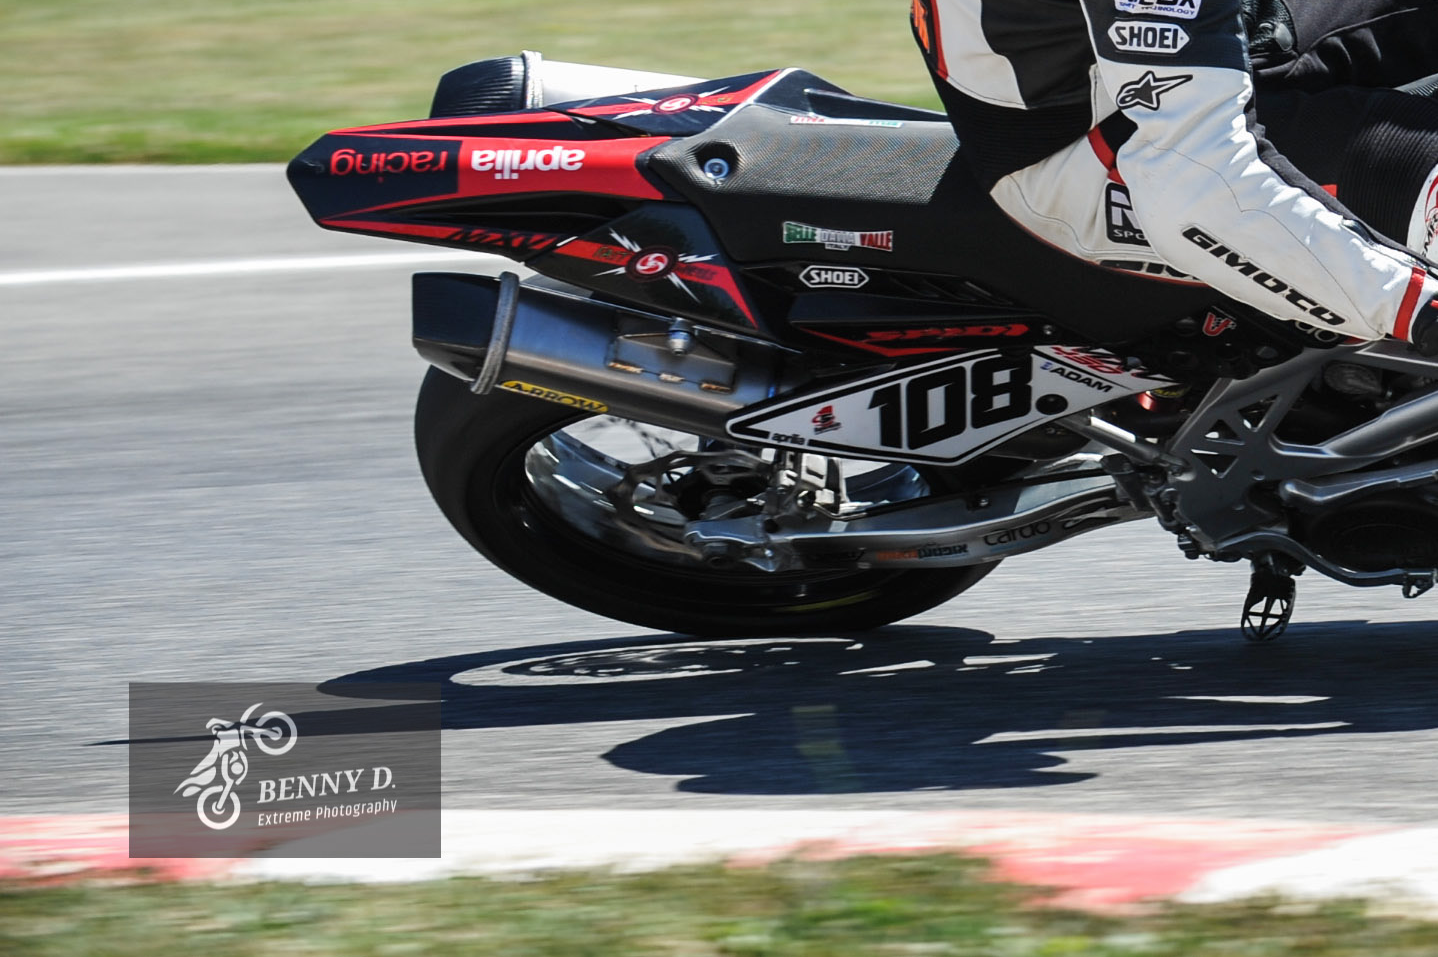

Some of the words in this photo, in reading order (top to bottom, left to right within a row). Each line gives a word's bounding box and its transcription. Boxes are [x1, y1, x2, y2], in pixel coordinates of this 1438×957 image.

[1115, 25, 1179, 50] SHOEI
[330, 148, 448, 183] racing
[471, 146, 586, 179] aprilia
[1113, 228, 1146, 240] SPO
[809, 269, 859, 285] SHOEI
[1050, 366, 1113, 393] ADAM
[514, 382, 602, 413] ARROW
[983, 520, 1050, 548] cardo
